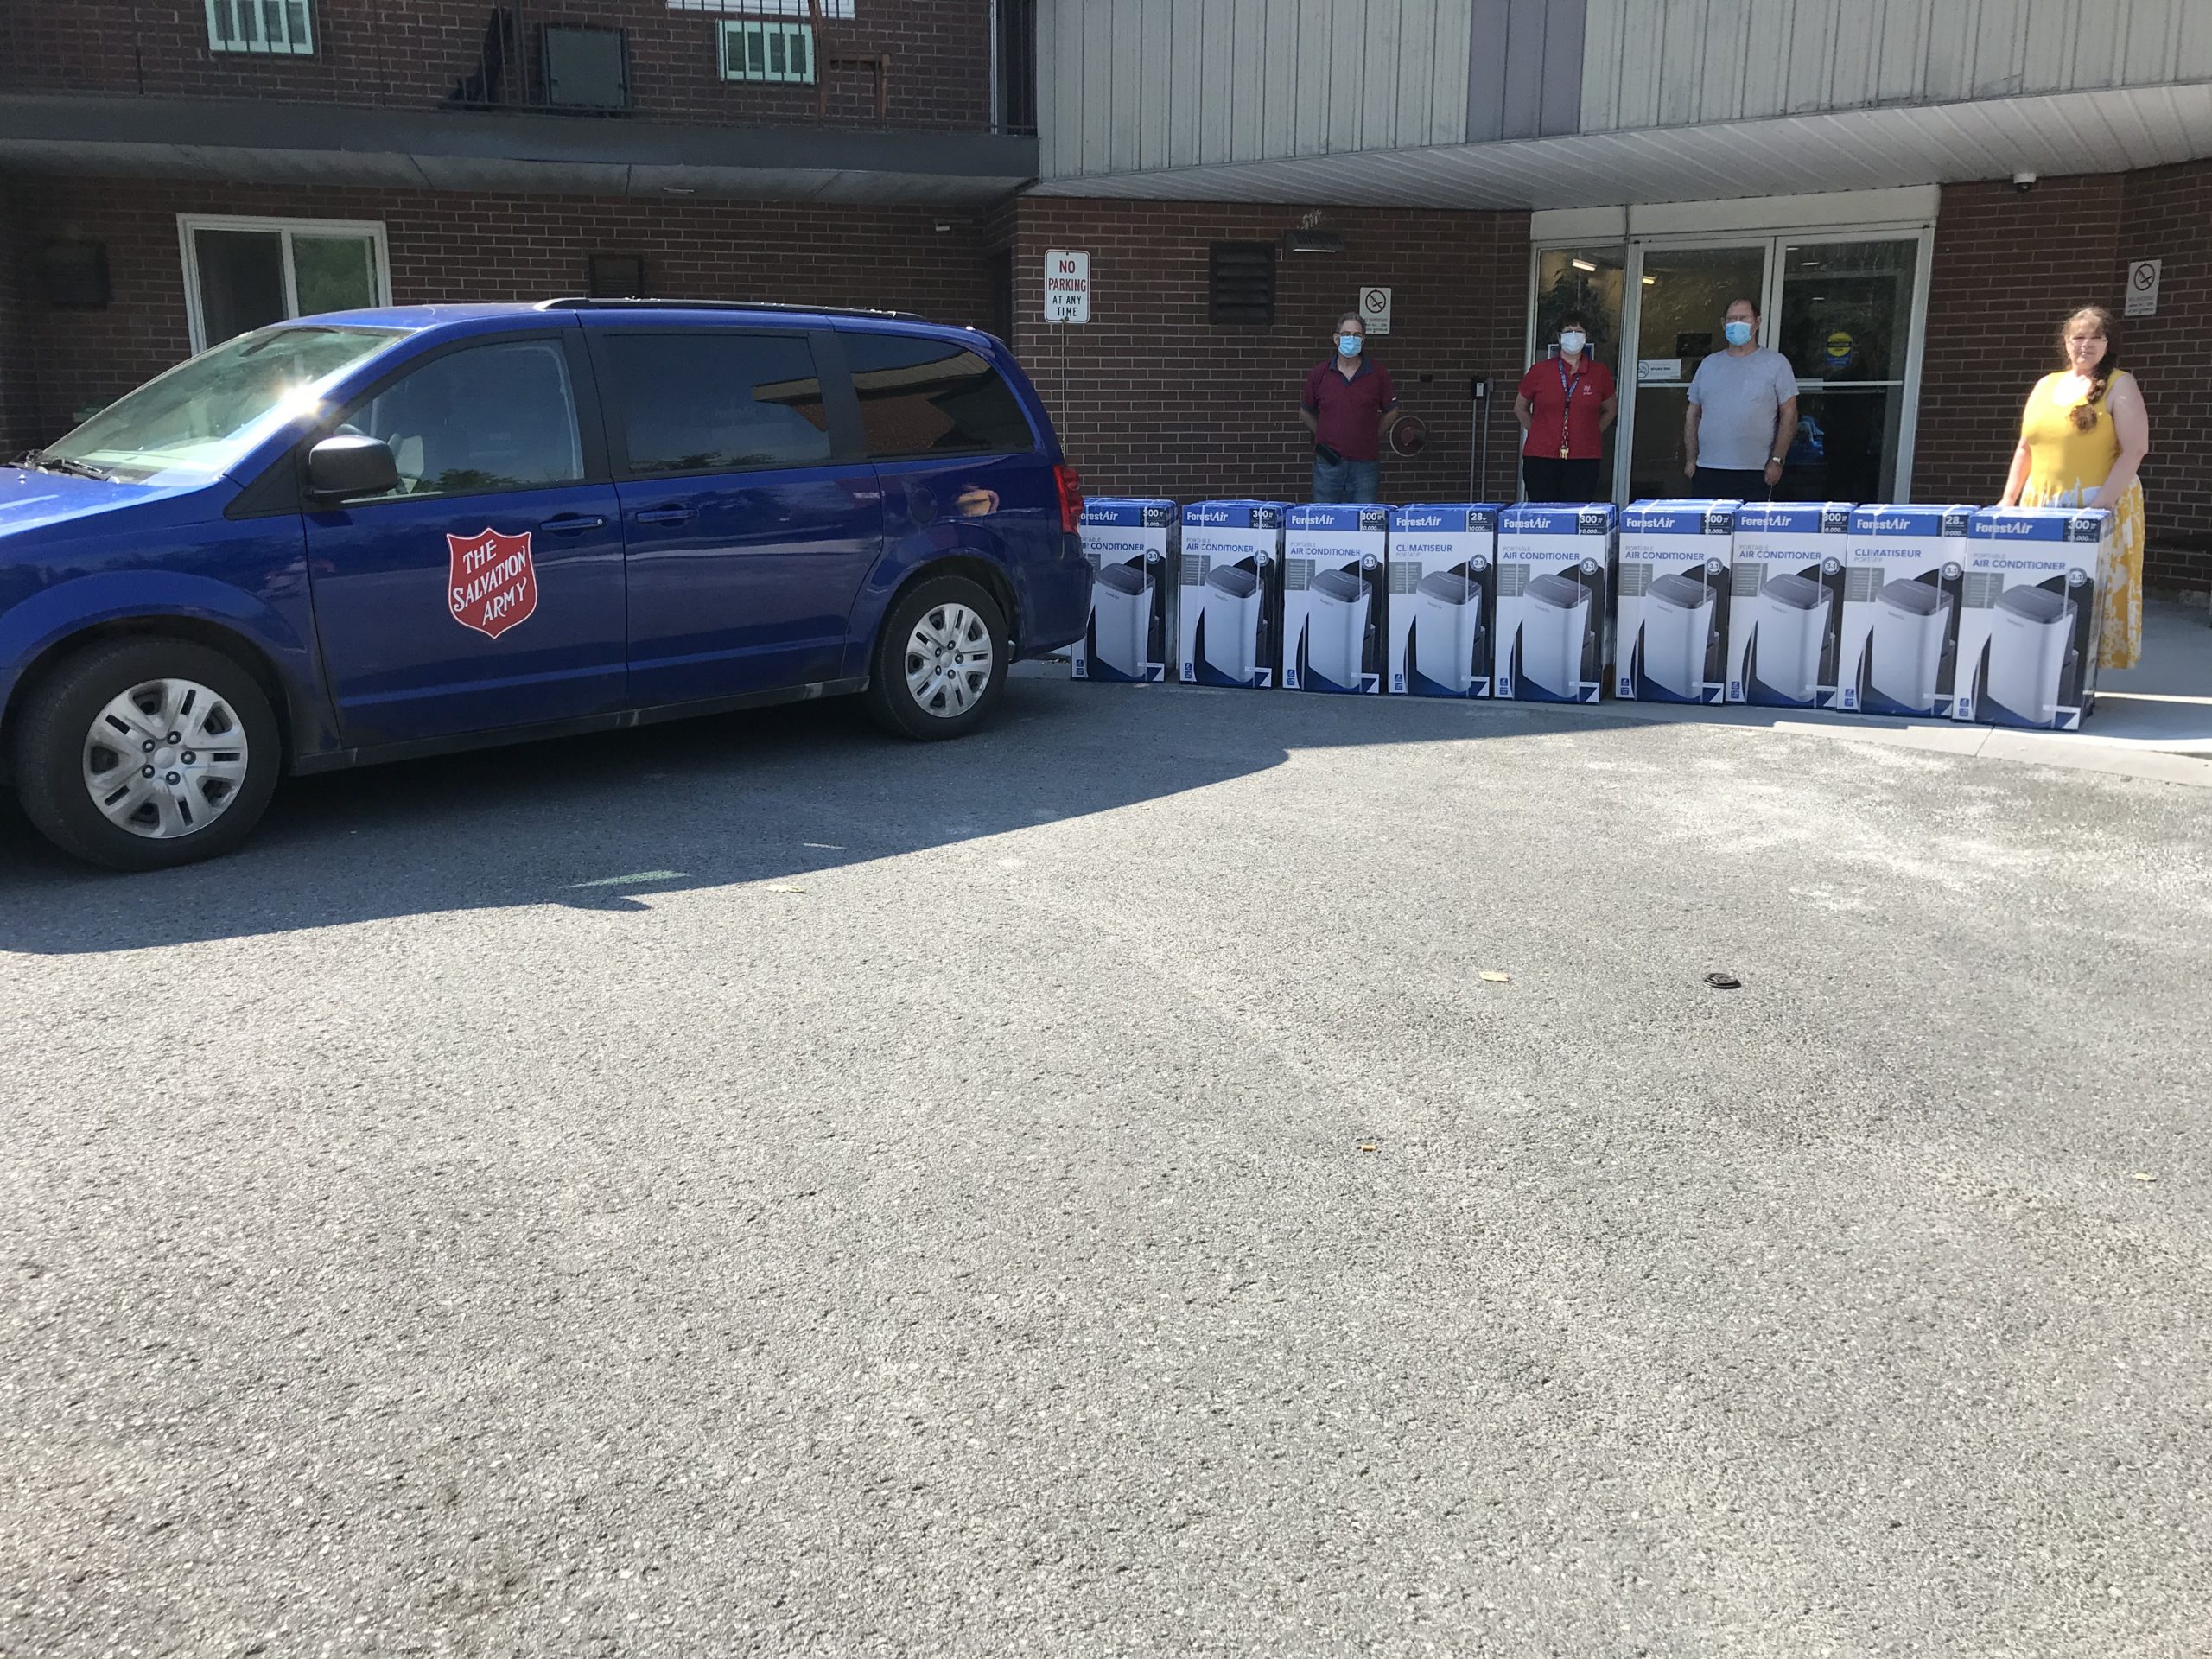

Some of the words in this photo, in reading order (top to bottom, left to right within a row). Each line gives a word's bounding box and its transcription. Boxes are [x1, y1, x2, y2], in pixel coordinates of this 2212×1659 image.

[1059, 260, 1076, 274] NO
[1048, 277, 1086, 292] PARKING
[1052, 296, 1062, 304] AT
[1065, 296, 1082, 305] ANY
[1057, 307, 1077, 317] TIME
[1080, 510, 1118, 521] orestAir
[1186, 512, 1228, 522] ForestAir
[1291, 514, 1335, 525] ForestAir
[1362, 512, 1376, 521] 300
[1396, 515, 1441, 526] ForestAir
[1471, 512, 1483, 521] 28
[1580, 515, 1597, 524] 300
[1704, 515, 1723, 524] 300
[1741, 515, 1792, 526] ForestAir
[1824, 513, 1841, 522] 300
[1945, 516, 1960, 524] 28
[1503, 518, 1552, 529] ForestAir
[1626, 517, 1675, 528] ForestAir
[1857, 518, 1910, 530] ForestAir
[2068, 520, 2089, 530] 300
[1975, 522, 2033, 534] ForestAir
[1201, 543, 1254, 552] CONDITIONER
[1305, 548, 1361, 556] CONDITIONER
[462, 538, 497, 575] THE
[1642, 552, 1705, 561] CONDITIONER
[1757, 551, 1821, 560] CONDITIONER
[1854, 549, 1922, 557] CLIMATISEUR
[1973, 559, 1989, 568] AIR
[1992, 560, 2066, 570] CONDITIONER
[452, 545, 526, 613] SALVATION
[482, 576, 527, 626] ARMY
